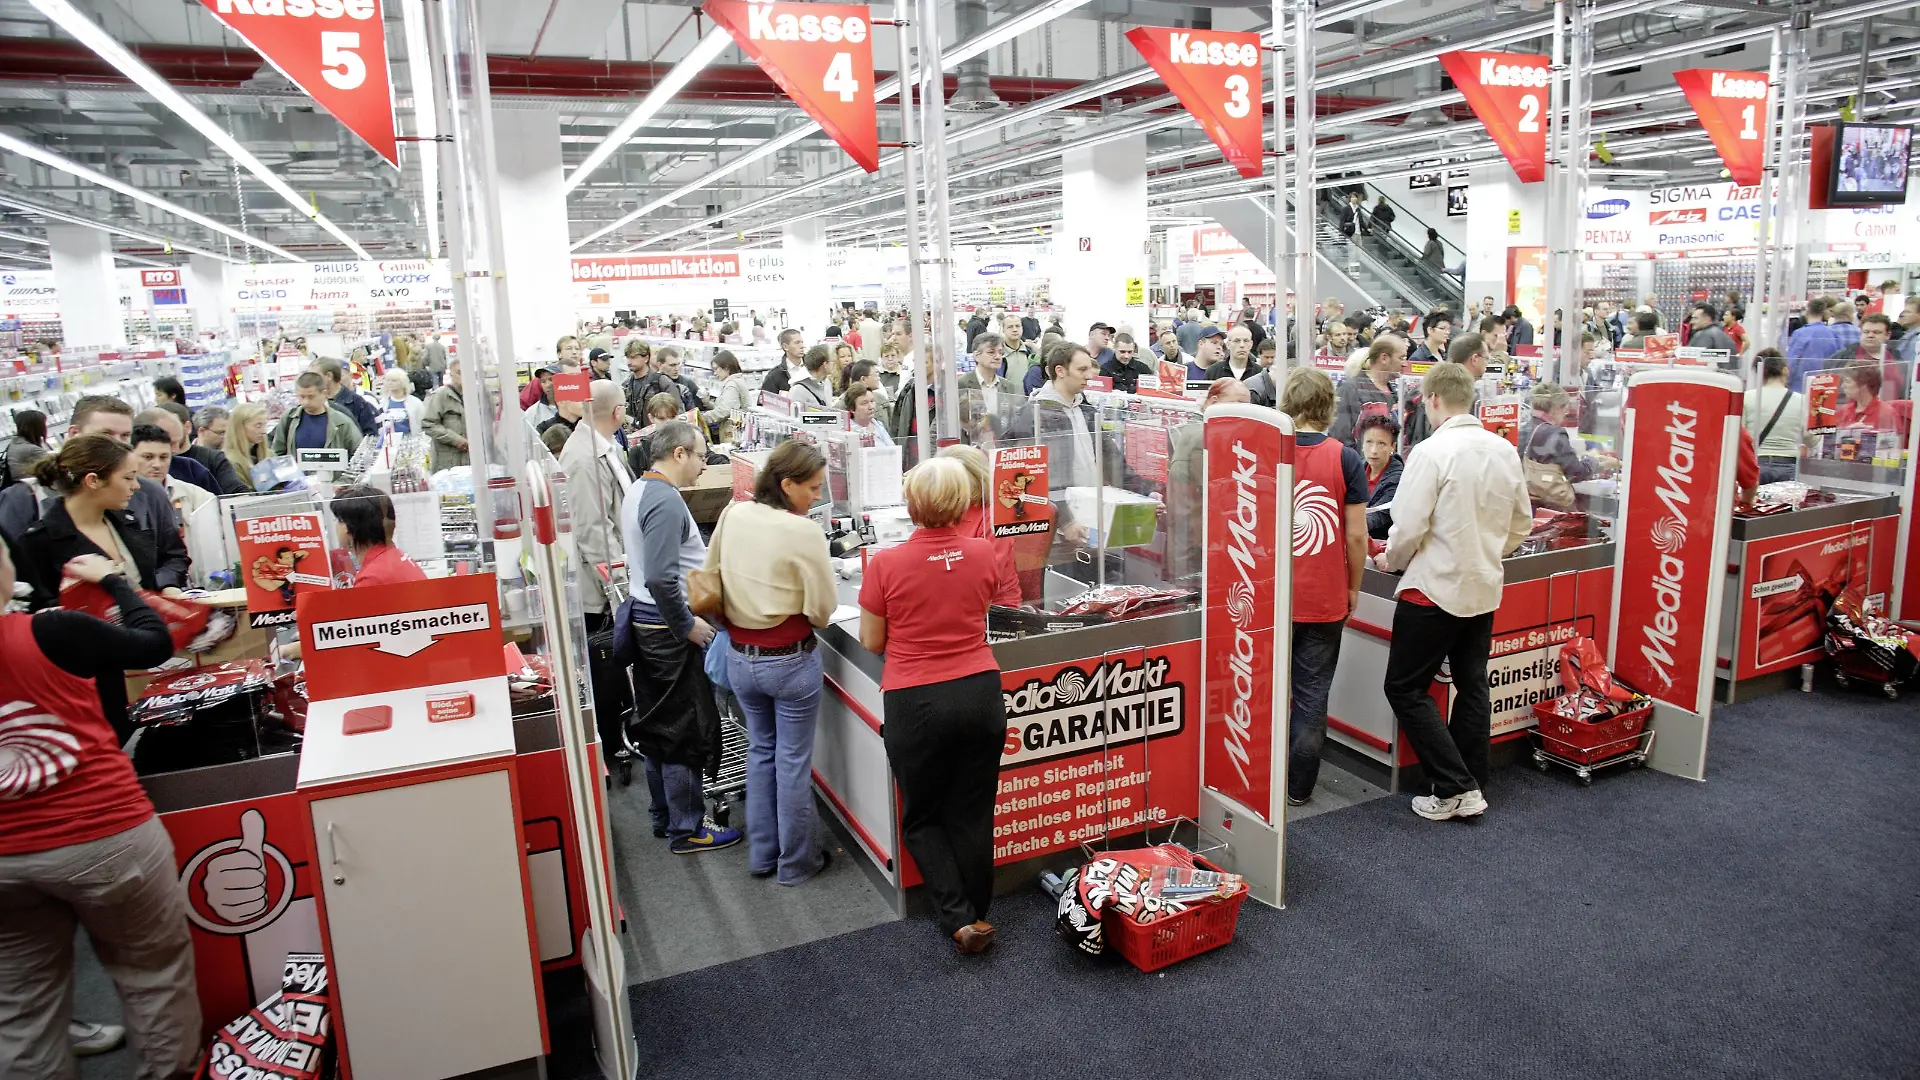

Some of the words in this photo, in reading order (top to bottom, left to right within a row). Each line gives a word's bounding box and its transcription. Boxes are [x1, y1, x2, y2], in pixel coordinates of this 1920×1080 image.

[748, 4, 867, 43] Kasse
[321, 31, 367, 90] 5
[1170, 32, 1258, 67] Kasse
[823, 52, 859, 103] 4
[1480, 57, 1548, 88] Kasse
[1223, 74, 1251, 118] 3
[1711, 72, 1767, 100] Kasse
[1518, 94, 1540, 133] 2
[1740, 104, 1758, 140] 1
[1650, 187, 1713, 205] SIGMA
[1651, 210, 1703, 225] Metz
[1854, 221, 1896, 237] Canon
[1585, 230, 1633, 244] PENTAX
[1659, 231, 1726, 245] Panasonic
[314, 263, 359, 273] PHILIPS
[378, 262, 425, 272] Canon
[383, 273, 431, 284] brother
[572, 258, 737, 279] lekommunikation
[238, 289, 288, 300] CASIO
[244, 277, 295, 287] SHARP
[310, 288, 350, 300] hama
[370, 287, 410, 298] SANYO
[1485, 405, 1515, 417] Endlich
[1000, 447, 1041, 462] Endlich
[1654, 400, 1698, 527] Markt
[247, 516, 312, 535] Endlich
[995, 525, 1021, 537] Media
[1026, 522, 1049, 533] Markt
[1228, 440, 1257, 596] Markt
[254, 533, 292, 544] blödes
[251, 612, 291, 627] Media
[319, 611, 485, 641] Meinungsmacher.
[1640, 552, 1685, 688] Media
[1528, 625, 1579, 647] Service.
[141, 694, 188, 708] Media
[197, 684, 237, 700] Markt
[1002, 682, 1056, 714] edia
[1080, 659, 1168, 701] Markt
[1488, 685, 1566, 714] anzierun
[1224, 628, 1254, 791] Media
[1002, 696, 1174, 756] SGARANTIE
[996, 776, 1040, 796] Jahre
[1043, 754, 1124, 785] Sicherheit
[993, 789, 1071, 816] ostenlose
[1075, 770, 1151, 798] Reparatur
[993, 809, 1072, 838] ostenlose
[1075, 796, 1131, 819] Hotline
[993, 834, 1050, 859] infache
[1053, 829, 1065, 845] &
[1068, 816, 1130, 842] schnelle
[1133, 807, 1167, 825] Hilfe
